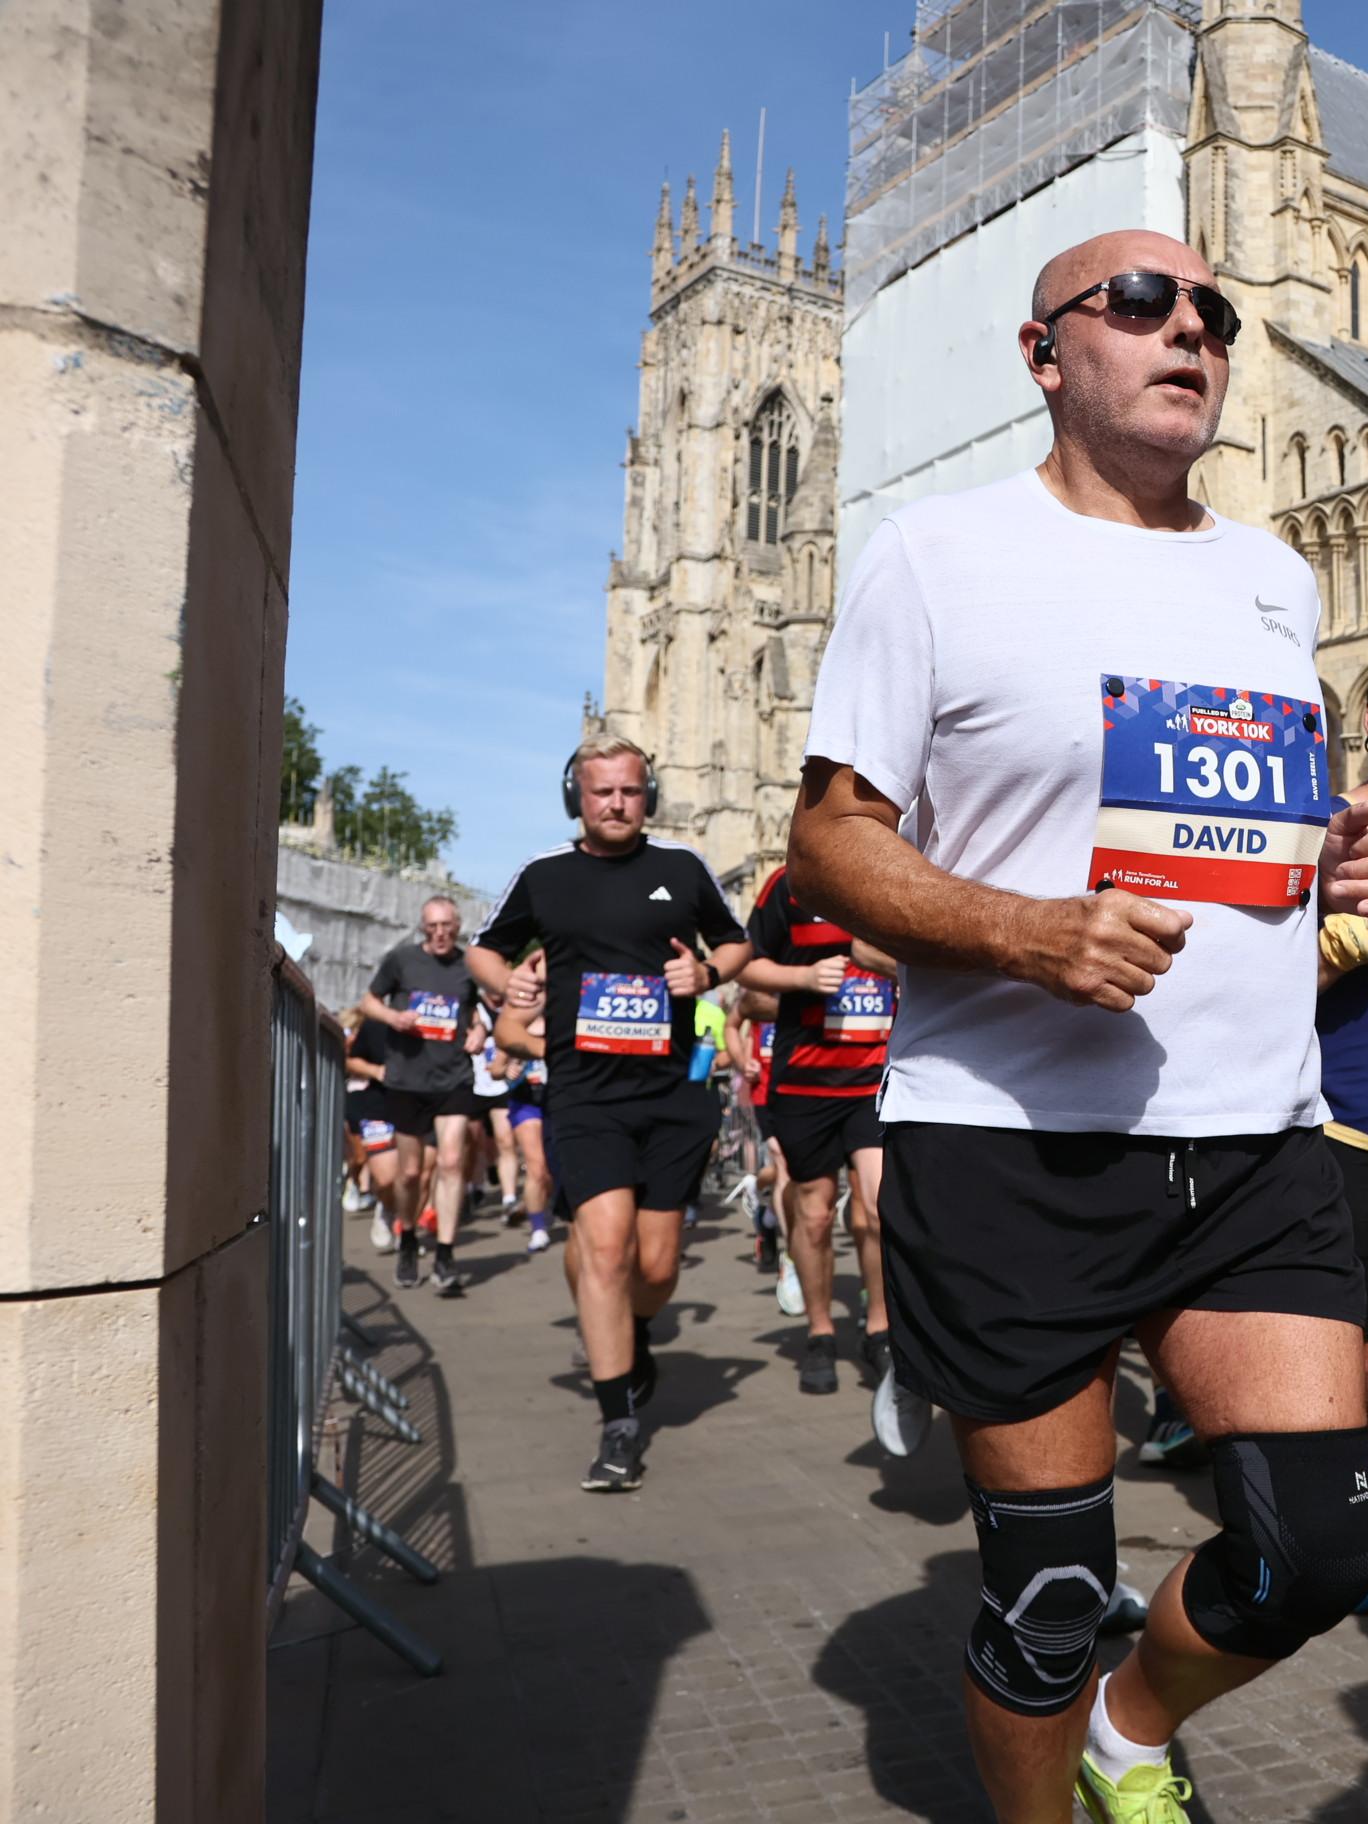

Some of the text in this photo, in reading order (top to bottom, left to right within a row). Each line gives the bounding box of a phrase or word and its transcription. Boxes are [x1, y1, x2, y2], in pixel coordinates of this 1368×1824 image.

[1192, 717, 1271, 740] YORK 10K
[1153, 742, 1286, 804] 1301
[1172, 823, 1268, 855] DAVID
[1124, 875, 1179, 889] RUN FOR ALL
[595, 996, 659, 1019] 5239
[838, 995, 884, 1013] 6195
[586, 1023, 661, 1036] MCCORMICK
